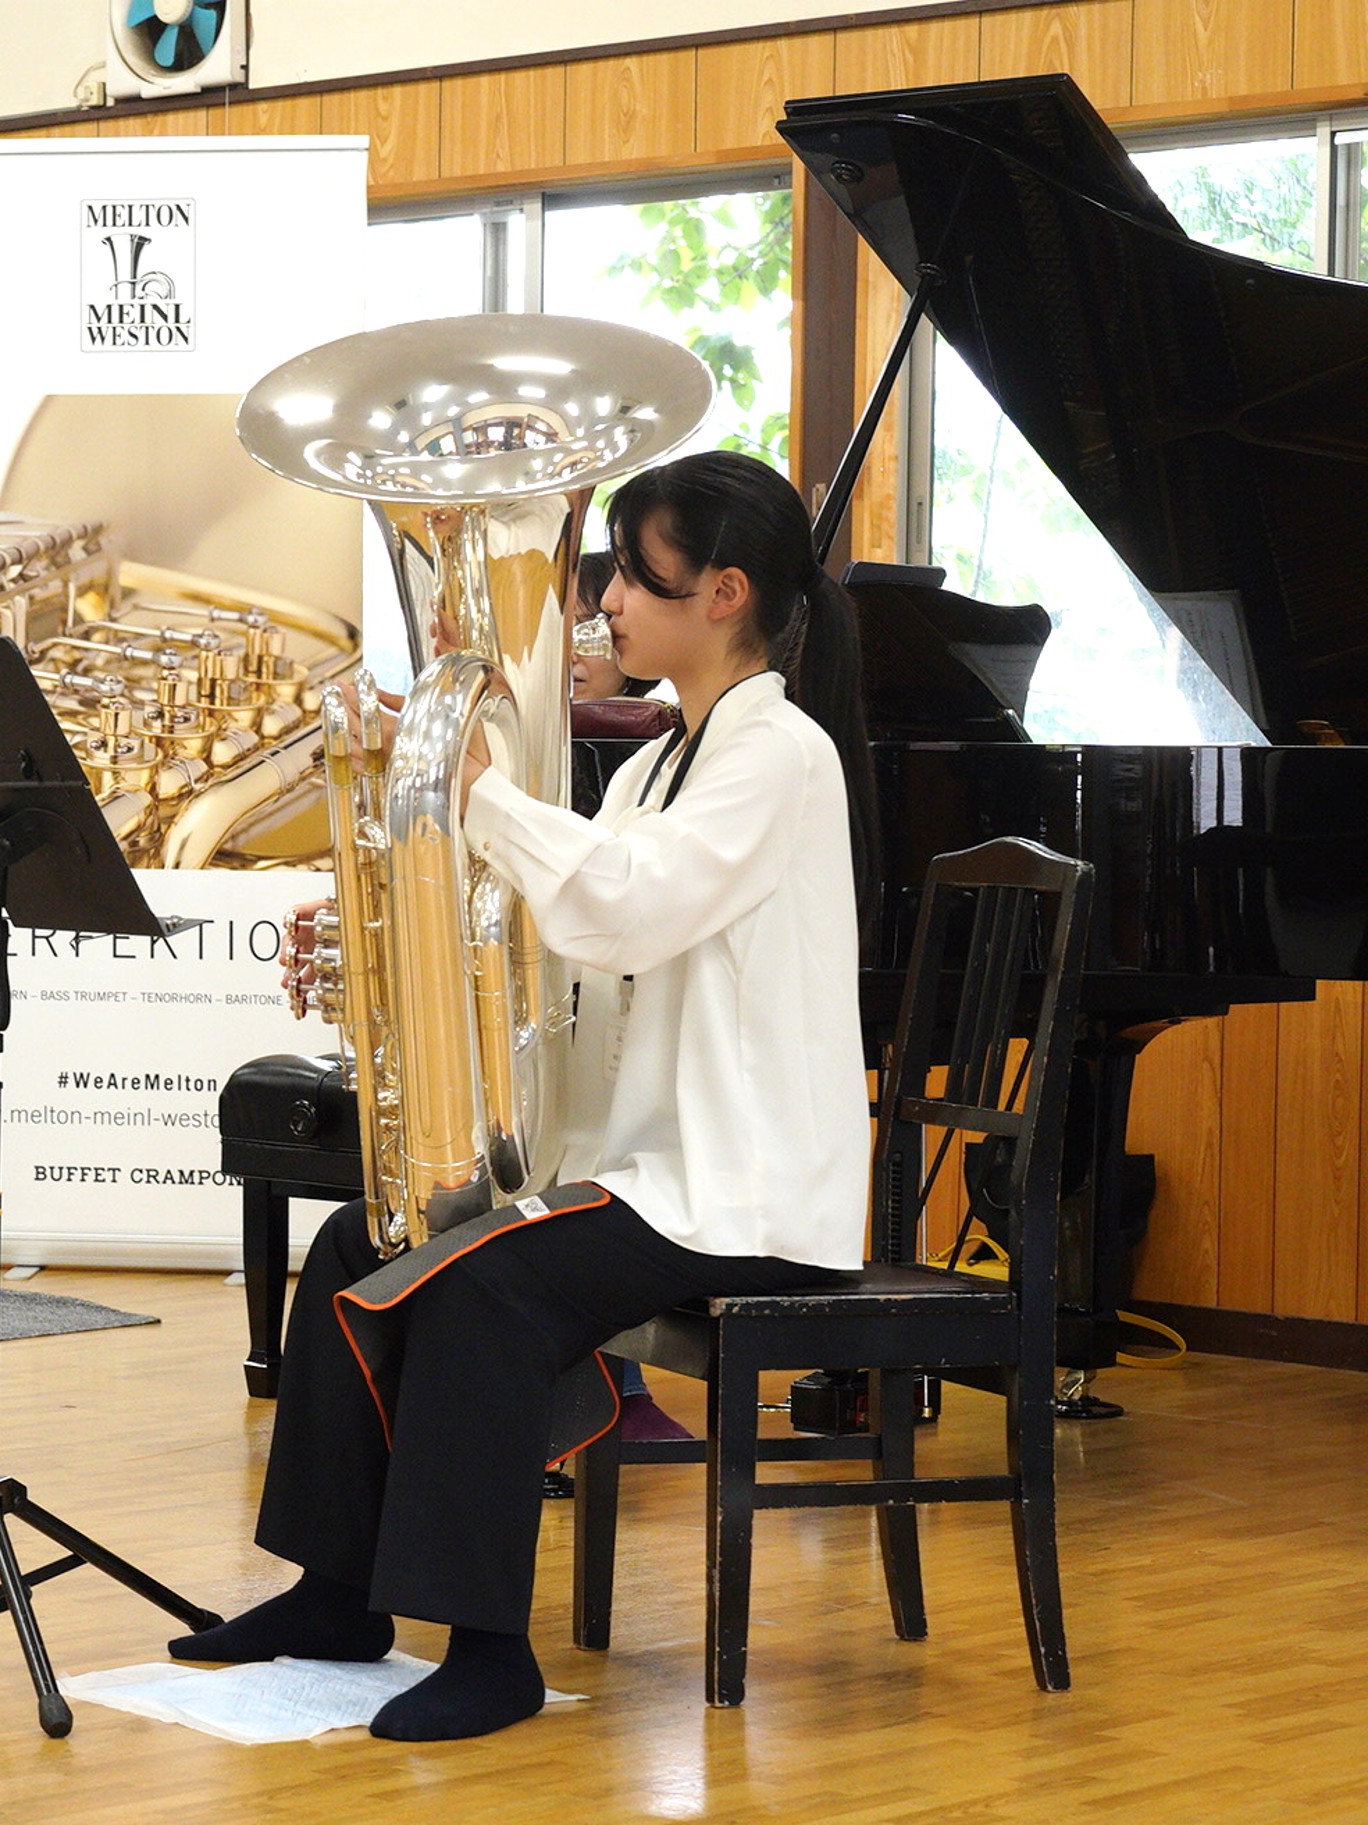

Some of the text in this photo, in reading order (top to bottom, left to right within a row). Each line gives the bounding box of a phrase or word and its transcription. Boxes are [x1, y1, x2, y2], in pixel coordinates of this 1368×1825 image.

[86, 203, 191, 228] MELTON
[87, 303, 191, 325] MEINL
[87, 325, 190, 347] WESTON
[40, 990, 70, 1002] BASS
[74, 991, 128, 1004] TRUMPET
[140, 992, 212, 1005] TENORHORN
[225, 994, 283, 1006] BARITONE
[57, 1071, 218, 1092] #WeAreMelton
[34, 1165, 244, 1187] BUFFET CRAMPON
